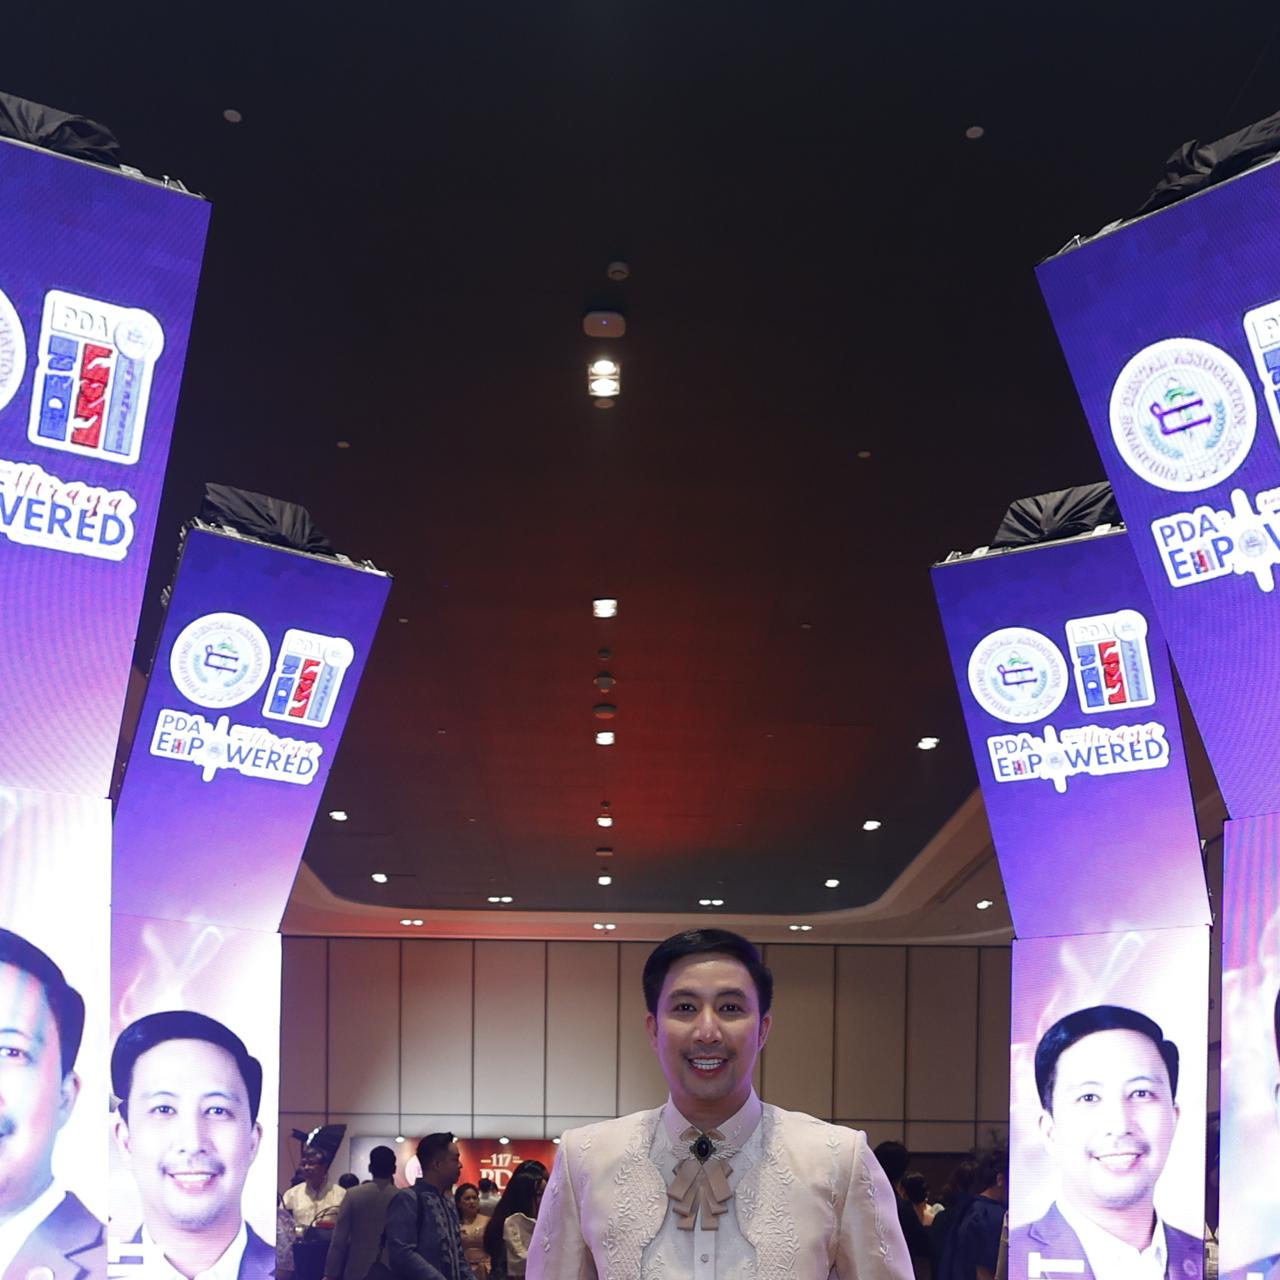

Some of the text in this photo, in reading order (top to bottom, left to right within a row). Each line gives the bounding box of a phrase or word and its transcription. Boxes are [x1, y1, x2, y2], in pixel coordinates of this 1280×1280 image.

[1159, 514, 1219, 547] PDA
[162, 714, 201, 735] PDA
[993, 738, 1033, 756] PDA
